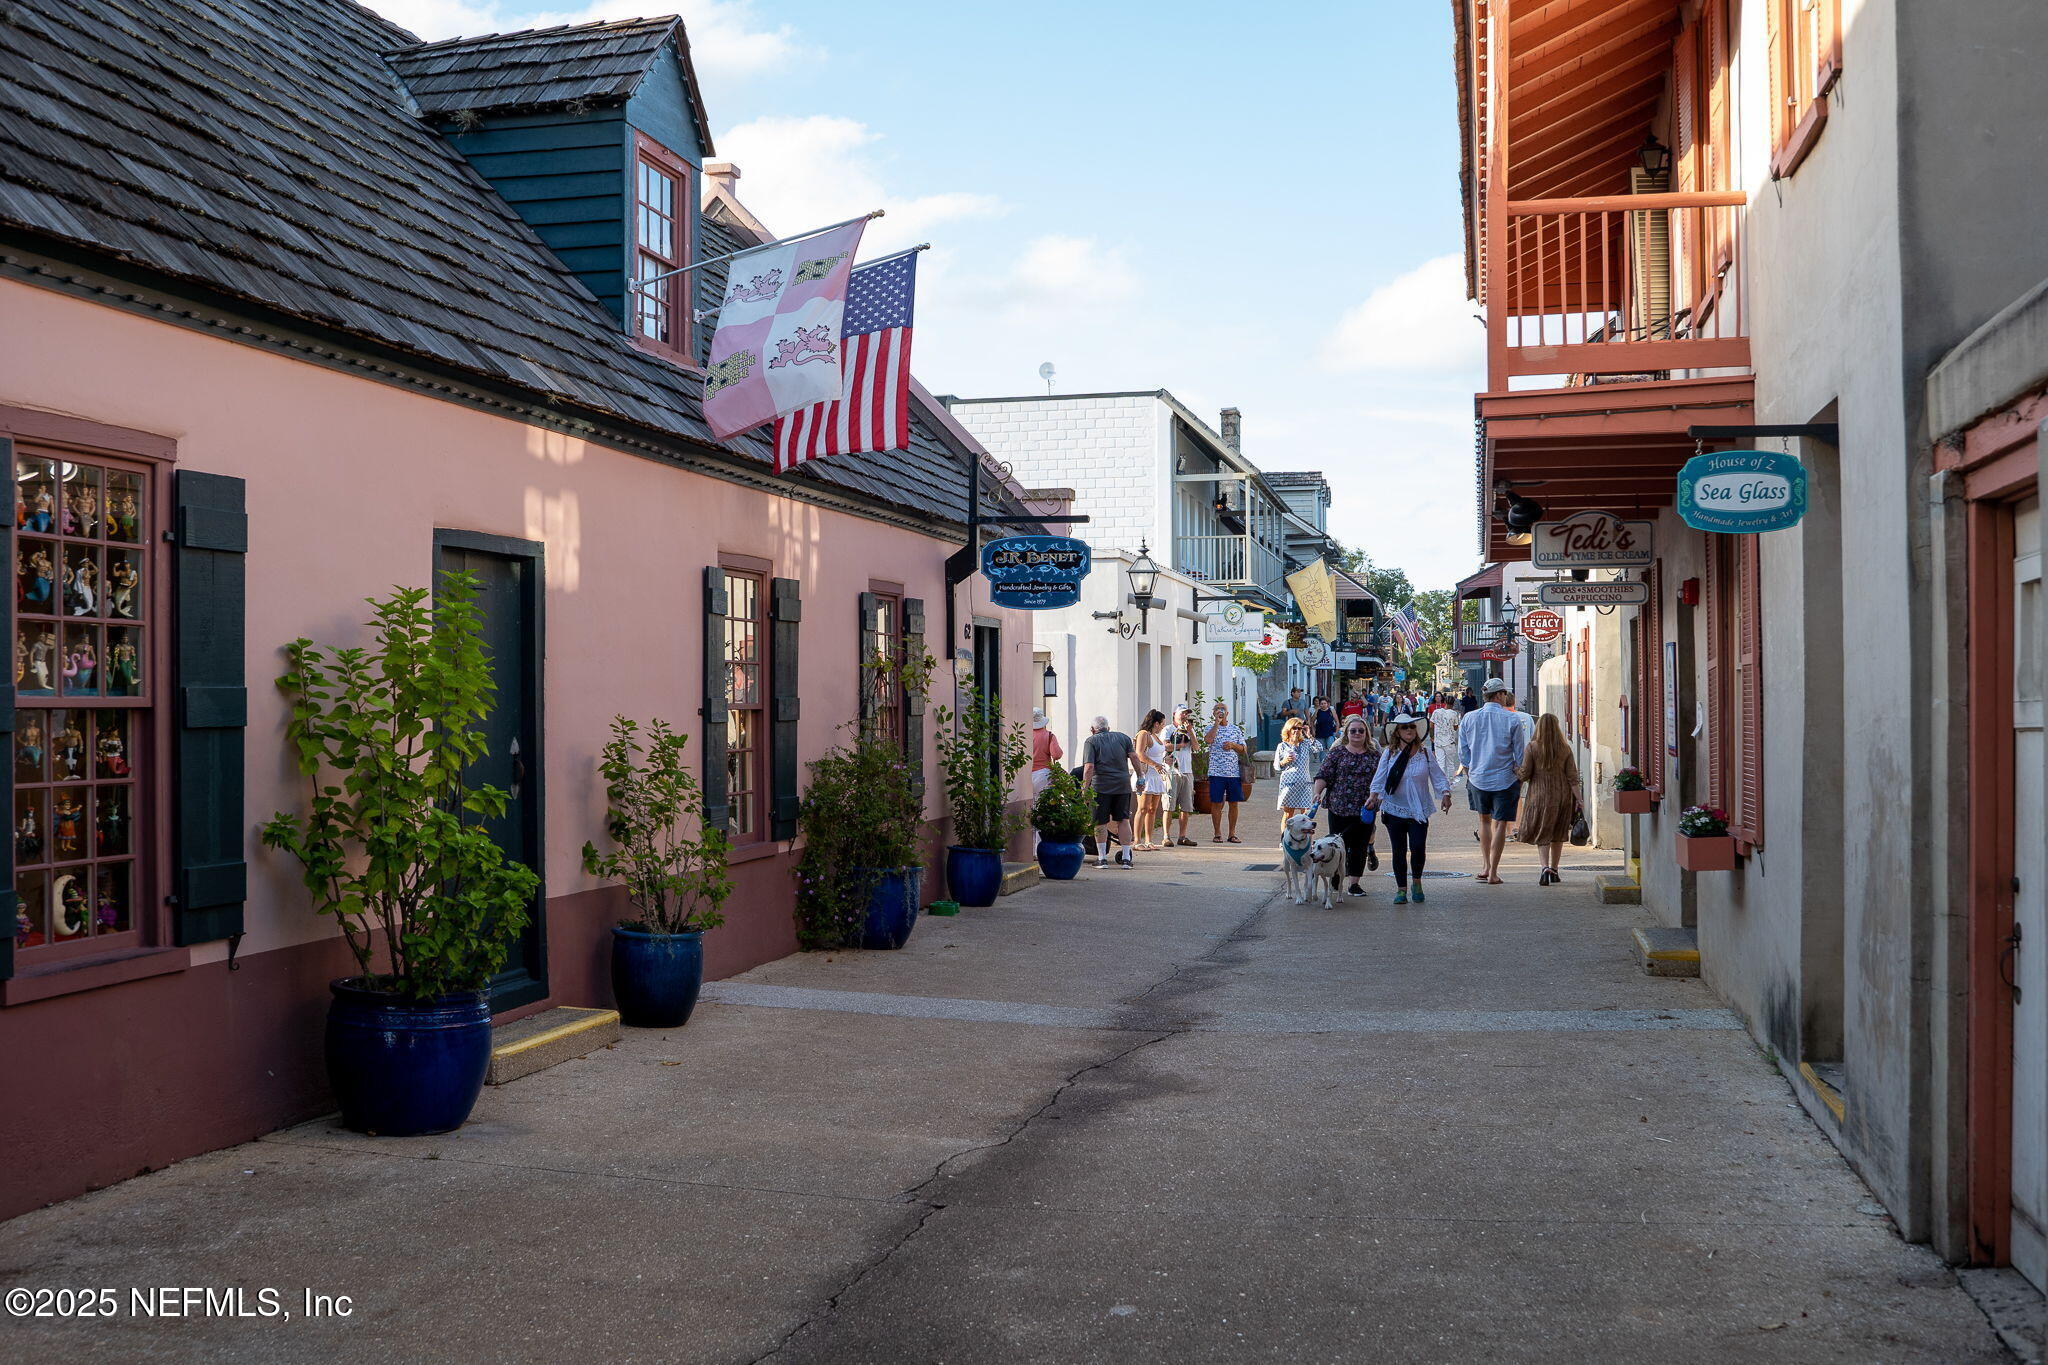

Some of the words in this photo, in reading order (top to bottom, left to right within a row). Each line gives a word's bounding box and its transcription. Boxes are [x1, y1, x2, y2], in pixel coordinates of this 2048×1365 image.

[1708, 456, 1746, 471] House
[1750, 456, 1766, 471] of
[1766, 460, 1776, 471] Z
[1700, 484, 1733, 501] Sea
[1739, 481, 1786, 503] Glass
[1693, 510, 1735, 526] Handmade
[1736, 517, 1768, 528] Jewelry
[1780, 509, 1794, 519] Art
[1538, 552, 1565, 562] OLDE
[1571, 551, 1593, 561] TYME
[1597, 551, 1613, 560] ICE
[1615, 550, 1650, 560] CREAM
[1000, 583, 1032, 591] Handcrafted
[1032, 583, 1052, 593] Jewelry
[1058, 583, 1072, 591] Gifts
[1551, 587, 1577, 595] SODAS
[1582, 586, 1634, 594] SMOOTHIES
[1563, 594, 1623, 602] CAPPUCCINO
[1524, 618, 1560, 628] LEGACY
[964, 623, 971, 639] 62
